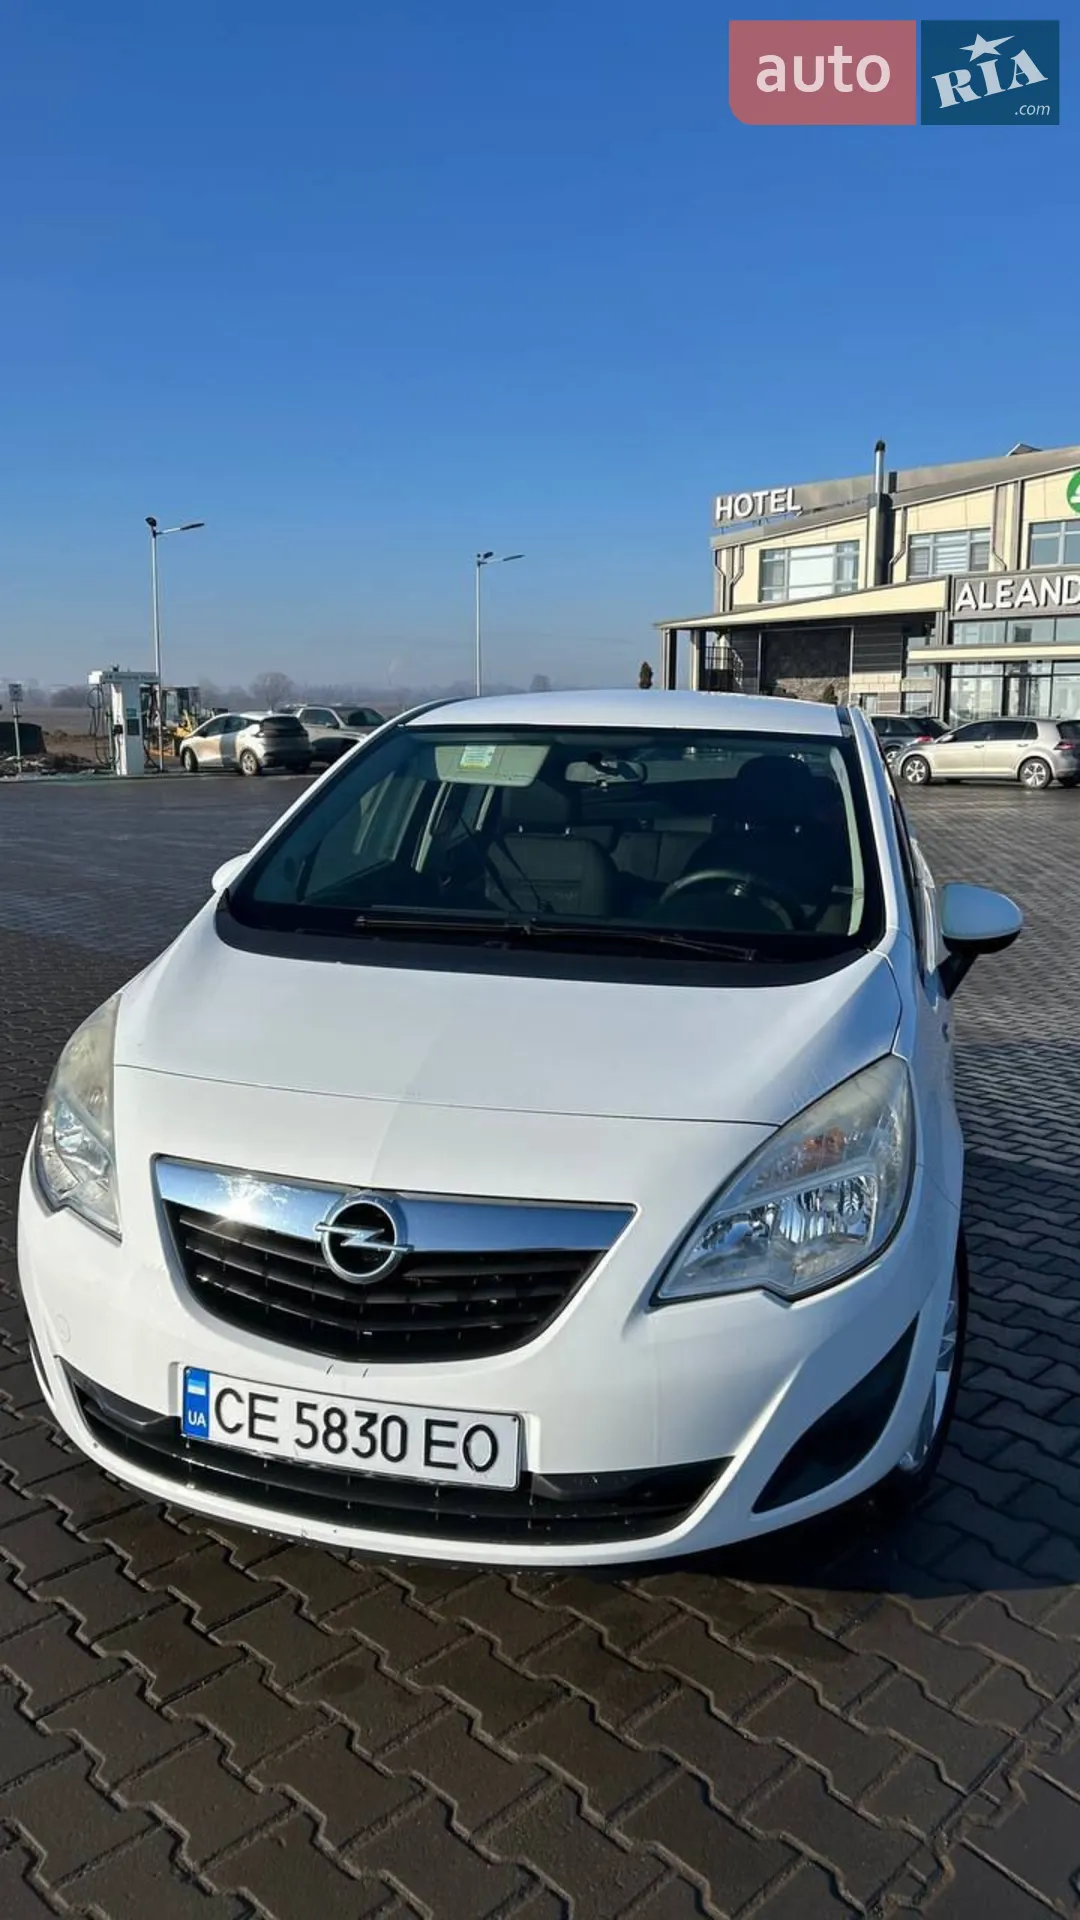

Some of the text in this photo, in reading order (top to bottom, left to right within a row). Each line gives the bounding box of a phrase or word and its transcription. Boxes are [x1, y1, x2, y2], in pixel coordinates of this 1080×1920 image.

[715, 487, 802, 521] HOTEL
[955, 575, 1080, 611] ALEAND
[187, 1410, 207, 1428] UA
[214, 1387, 499, 1472] CE 5830 EO
